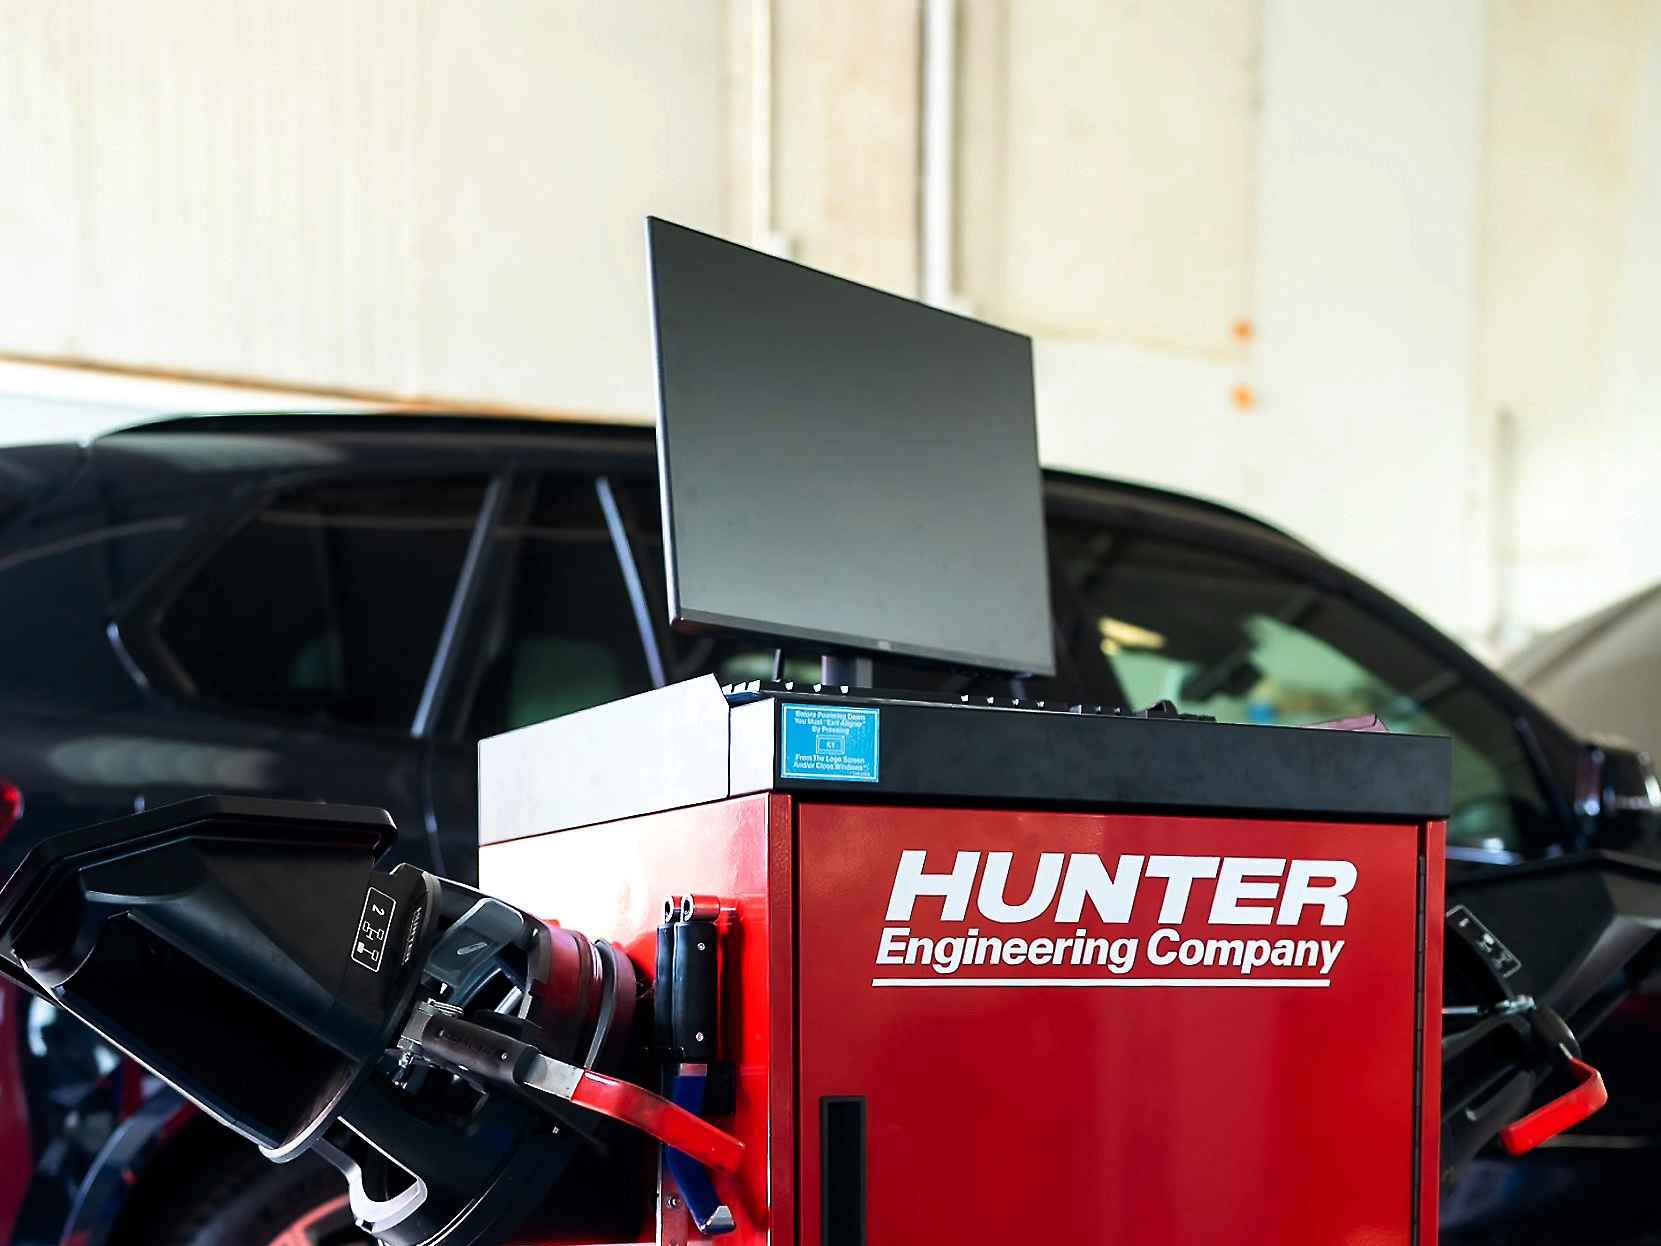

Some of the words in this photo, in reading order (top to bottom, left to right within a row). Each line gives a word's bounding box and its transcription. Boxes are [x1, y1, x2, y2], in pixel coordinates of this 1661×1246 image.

[372, 904, 385, 916] 2
[884, 849, 1358, 926] HUNTER
[876, 927, 1139, 974] Engineering
[1146, 928, 1344, 974] Company
